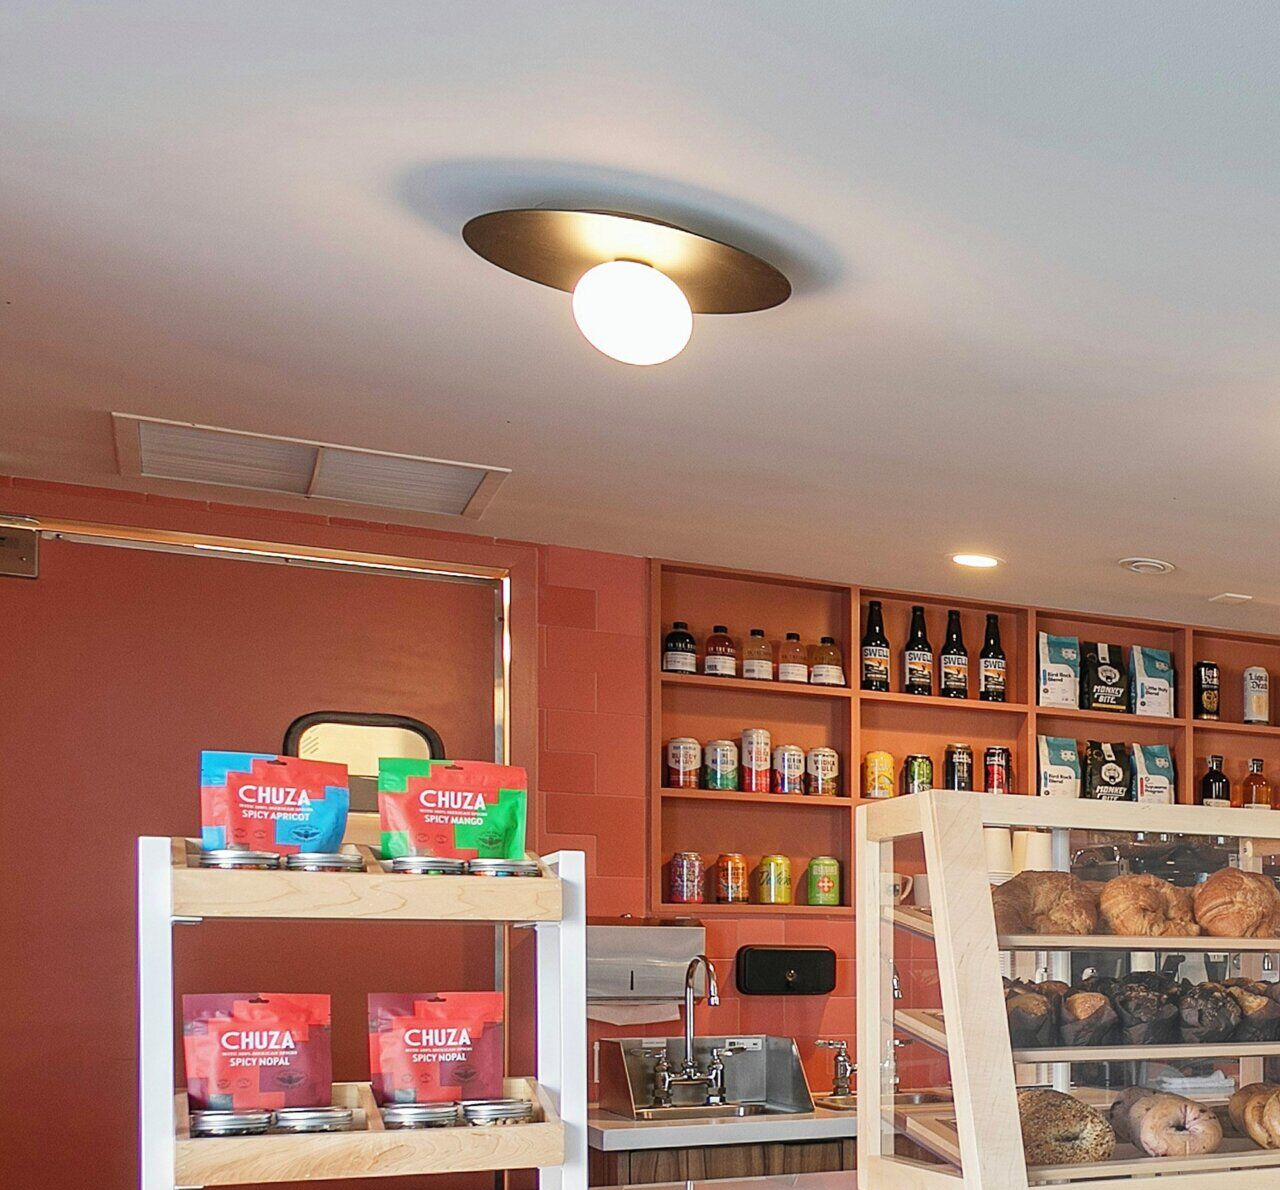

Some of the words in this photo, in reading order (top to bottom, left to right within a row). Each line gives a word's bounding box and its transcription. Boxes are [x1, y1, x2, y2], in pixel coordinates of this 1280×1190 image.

[864, 648, 889, 659] SWELL
[943, 656, 968, 666] SWELL
[1093, 684, 1124, 696] MONKEY
[1098, 695, 1117, 704] BITE
[238, 785, 311, 806] CHUZA
[1095, 785, 1128, 797] MONKEY
[419, 789, 487, 811] CHUZA
[242, 809, 269, 820] SPICY
[270, 812, 311, 822] APRICOT
[425, 814, 450, 824] SPICY
[450, 816, 484, 826] MANGO
[220, 1030, 296, 1050] CHUZA
[404, 1028, 472, 1047] CHUZA
[229, 1057, 257, 1067] SPICY
[259, 1056, 291, 1066] NOPAL
[412, 1053, 438, 1063] SPICY
[438, 1052, 467, 1062] NOPAL
